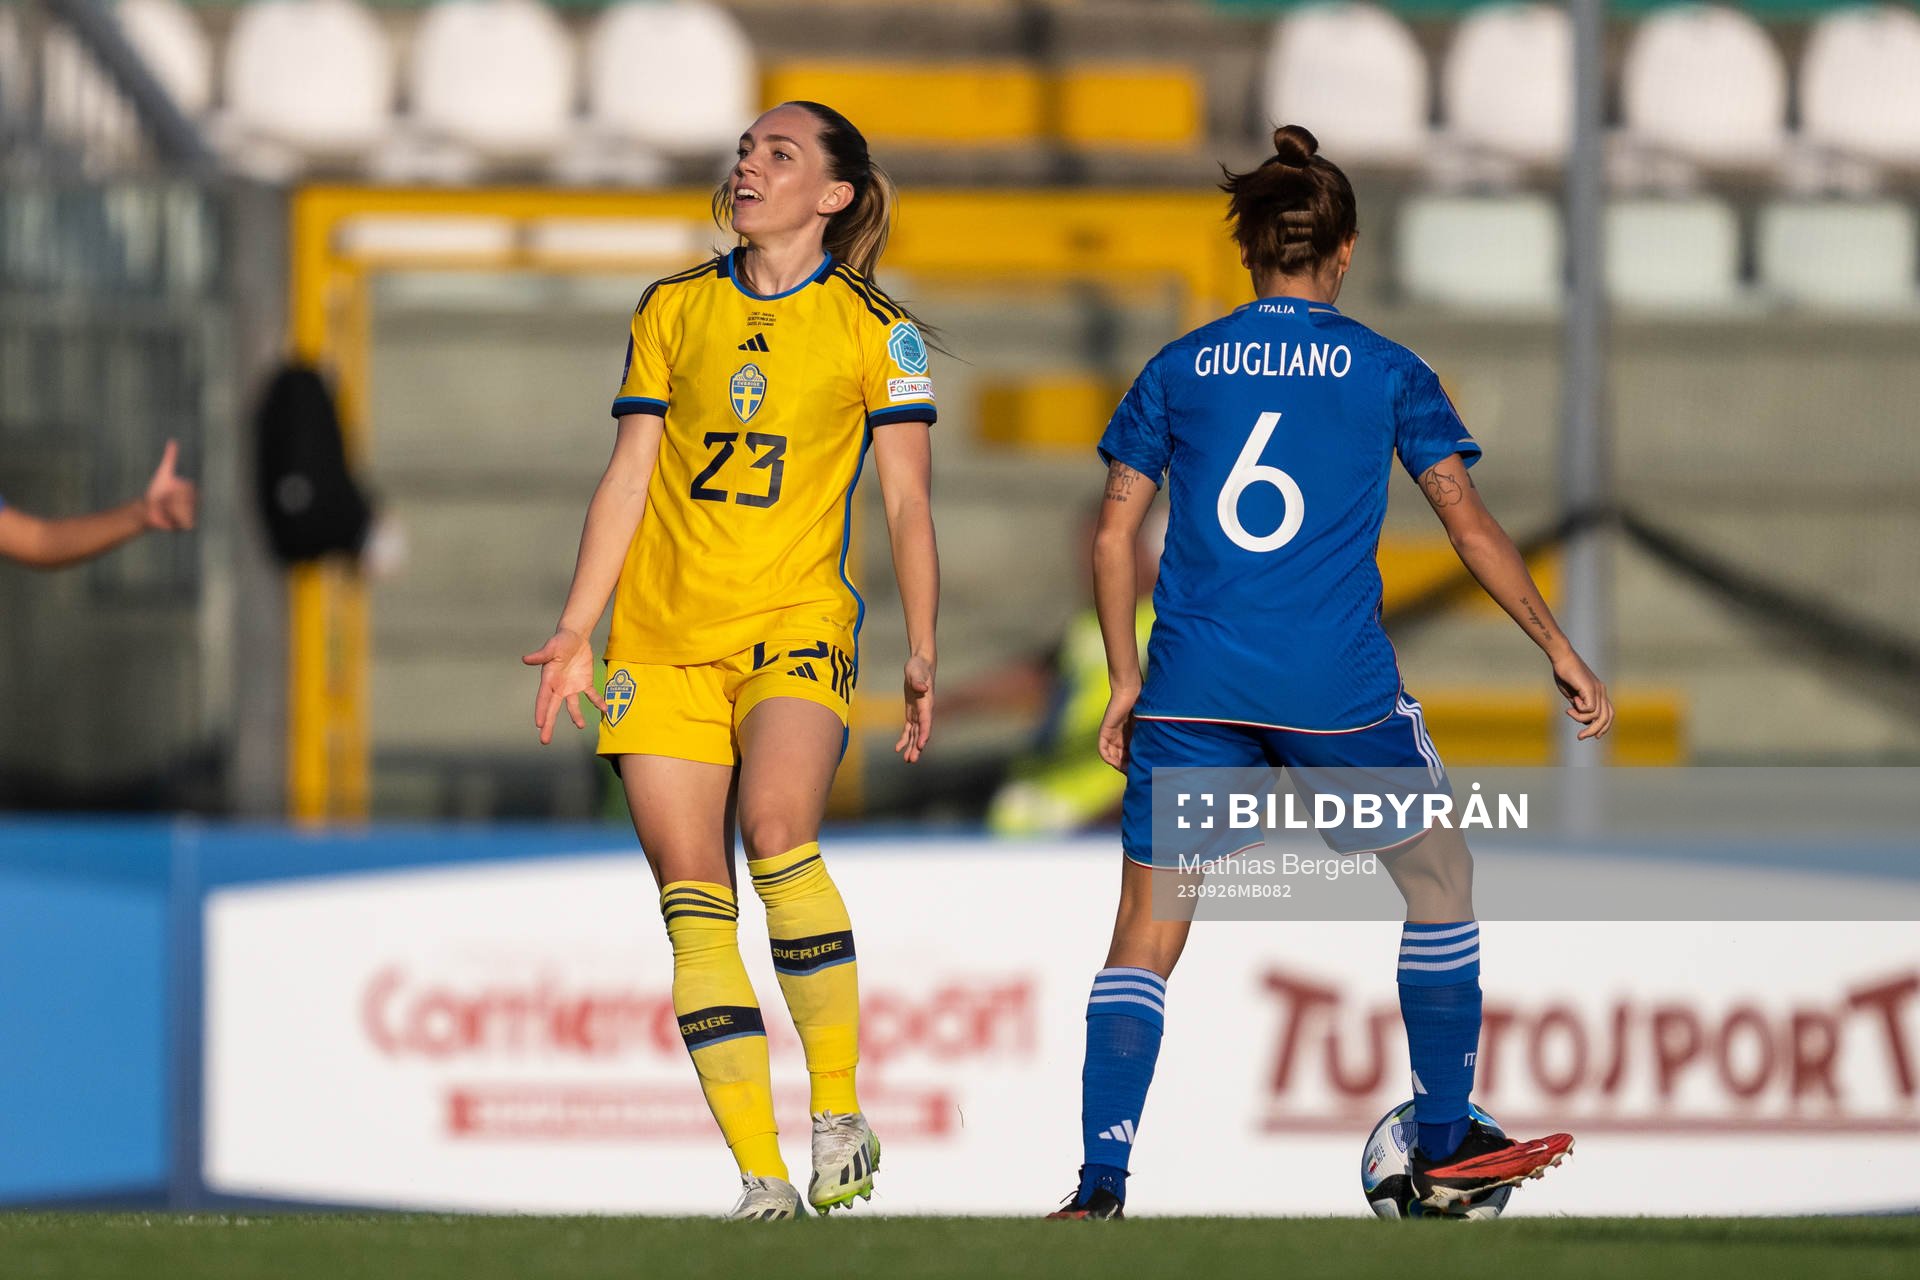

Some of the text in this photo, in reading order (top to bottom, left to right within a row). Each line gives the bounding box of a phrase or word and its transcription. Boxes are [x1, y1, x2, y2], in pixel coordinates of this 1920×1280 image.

[1258, 303, 1296, 314] ITALIA
[1194, 341, 1352, 378] GIUGLIANO
[690, 431, 787, 508] 23
[1217, 411, 1304, 552] 6
[773, 940, 843, 961] SVERIGE
[1264, 965, 1920, 1106] TUTOSPORT
[1463, 1052, 1477, 1068] IT
